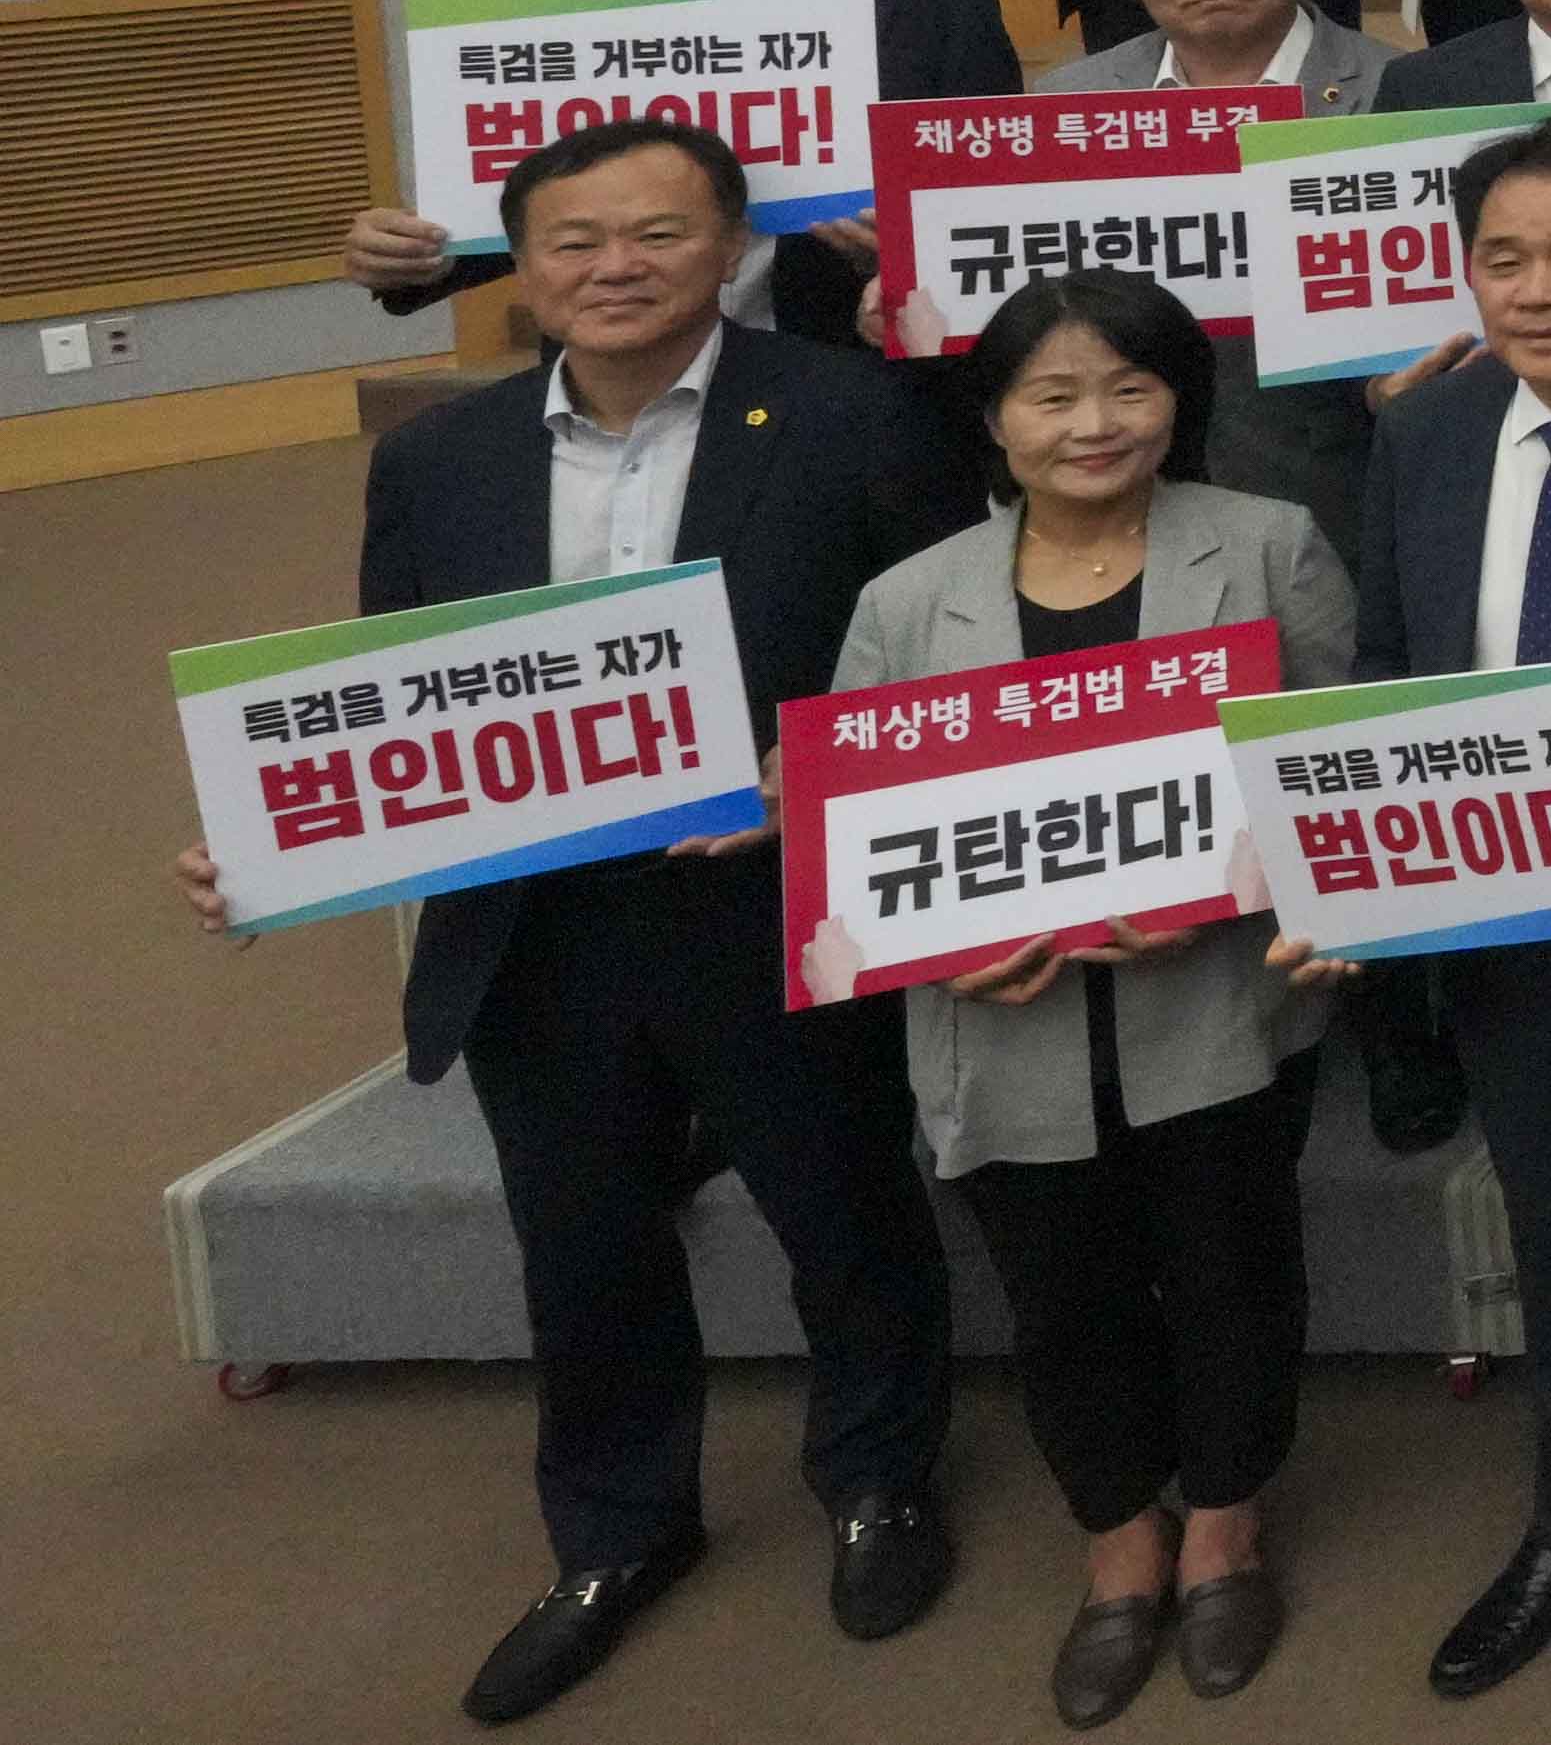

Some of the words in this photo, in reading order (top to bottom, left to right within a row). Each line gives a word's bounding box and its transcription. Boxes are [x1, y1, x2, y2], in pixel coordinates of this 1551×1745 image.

[459, 41, 577, 85] 특검을
[592, 35, 743, 79] 거부하는
[759, 30, 832, 71] 자가
[243, 682, 387, 744] 특검을
[400, 650, 582, 724] 거부하는
[595, 628, 683, 680] 자가
[833, 692, 971, 751] 채상병
[992, 664, 1124, 728] 특검법
[1145, 647, 1229, 698] 부결
[260, 686, 700, 851] 범인이다!
[1275, 748, 1383, 797] 특검을
[1388, 733, 1532, 785] 거부하는
[868, 773, 1214, 919] 규탄한다!
